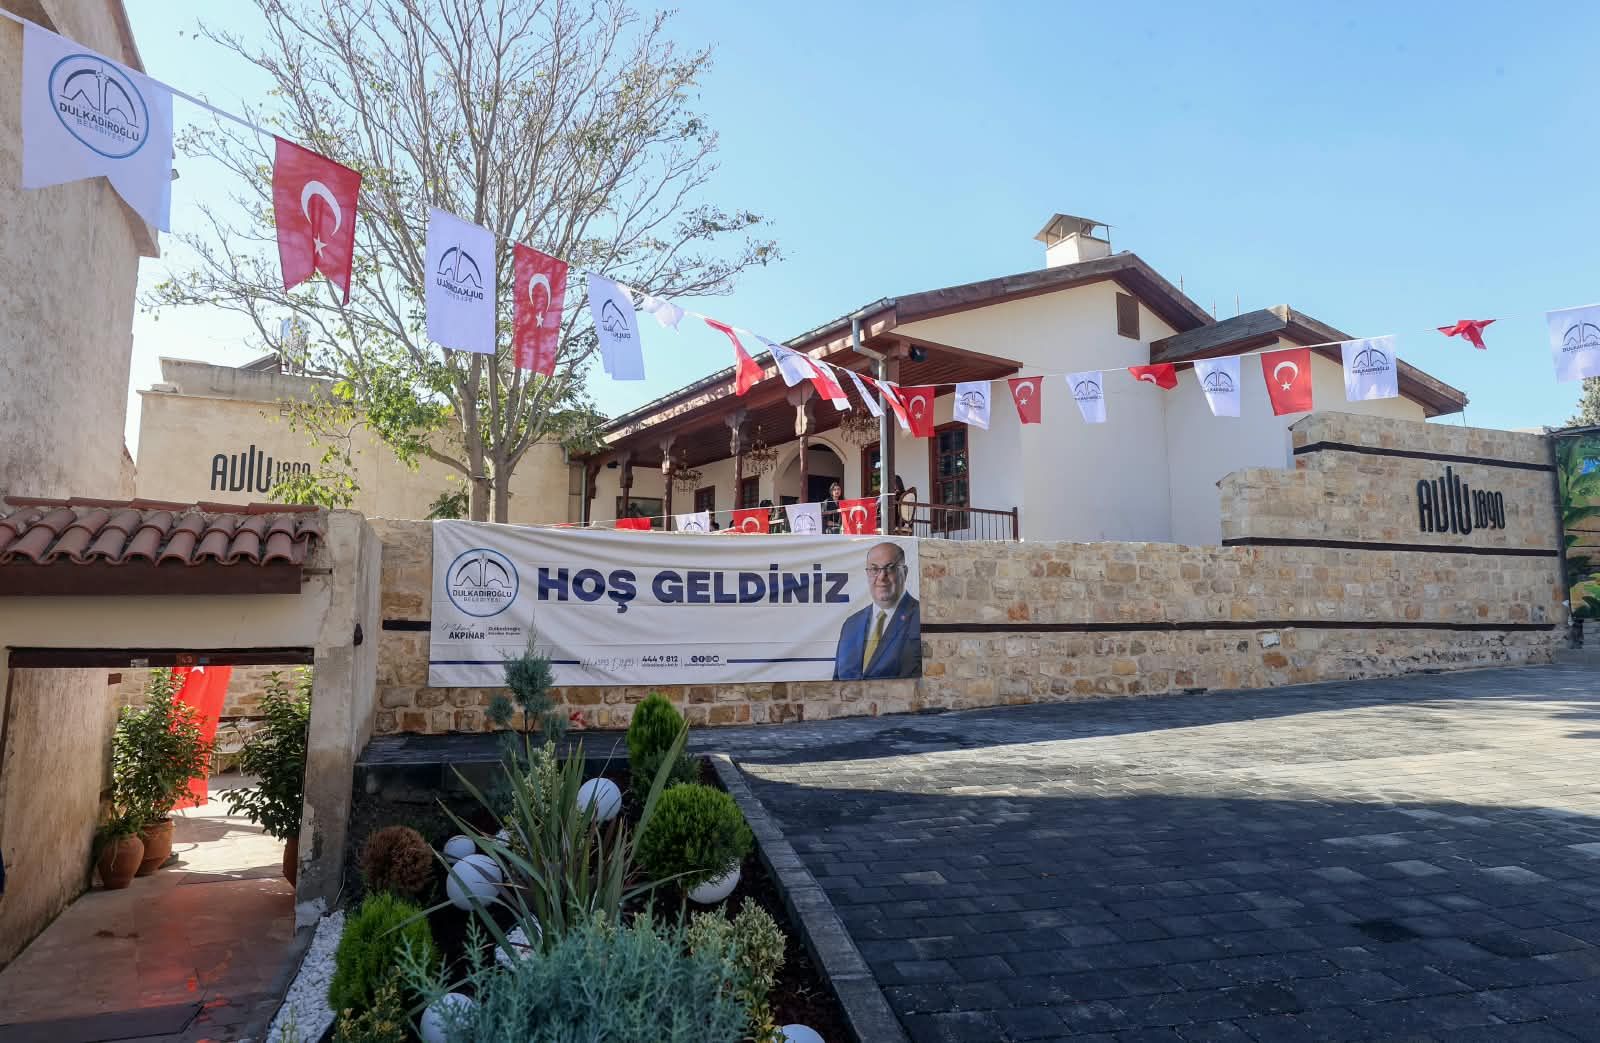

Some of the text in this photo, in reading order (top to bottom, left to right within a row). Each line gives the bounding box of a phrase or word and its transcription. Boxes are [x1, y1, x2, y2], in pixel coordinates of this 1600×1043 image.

[1472, 489, 1506, 530] 1890
[537, 563, 850, 614] HOŞ GELDİNİZ
